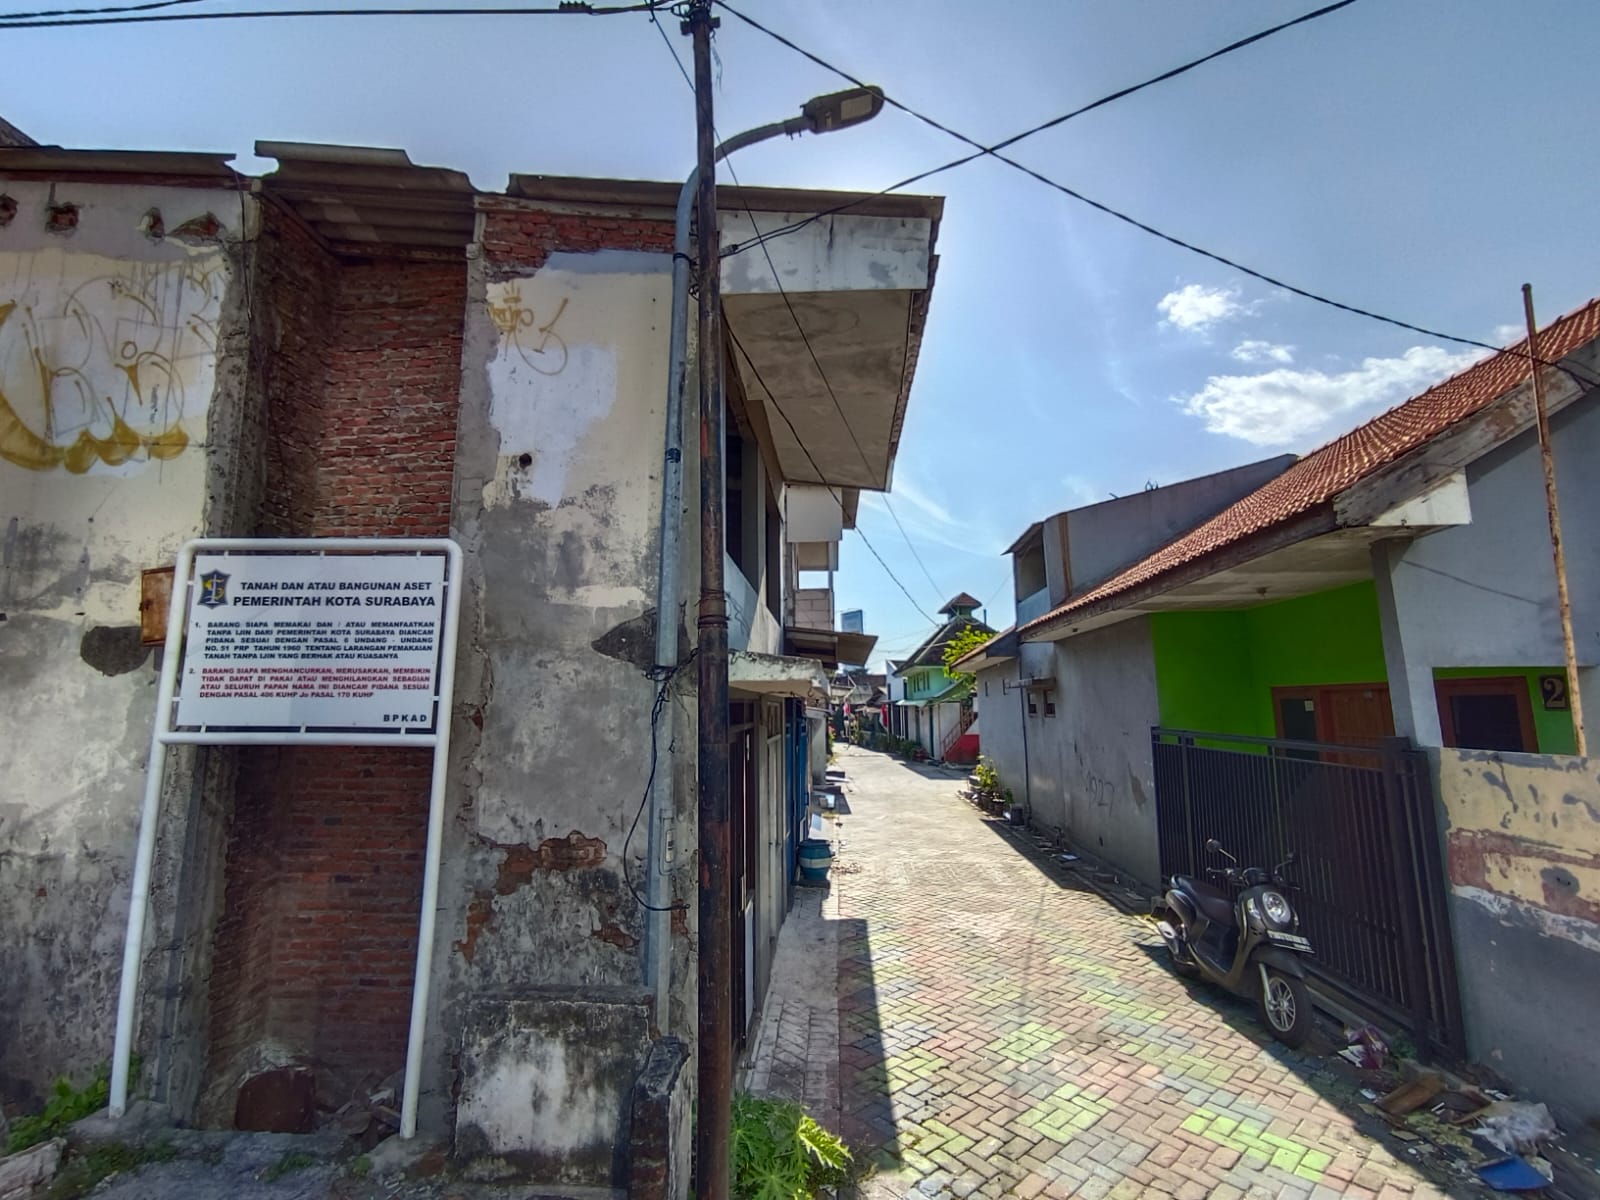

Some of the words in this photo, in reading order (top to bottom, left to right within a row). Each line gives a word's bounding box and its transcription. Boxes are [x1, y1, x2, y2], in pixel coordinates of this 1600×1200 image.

[241, 582, 278, 590] TANAH
[282, 582, 304, 590] DAN
[307, 582, 336, 590] ATAU
[339, 582, 401, 590] BANGUNAN
[404, 582, 432, 590] ASET
[233, 597, 321, 606] PEMERINTAH
[326, 597, 361, 606] KOTA
[365, 597, 436, 606] SURABAYA
[1544, 679, 1565, 707] 2
